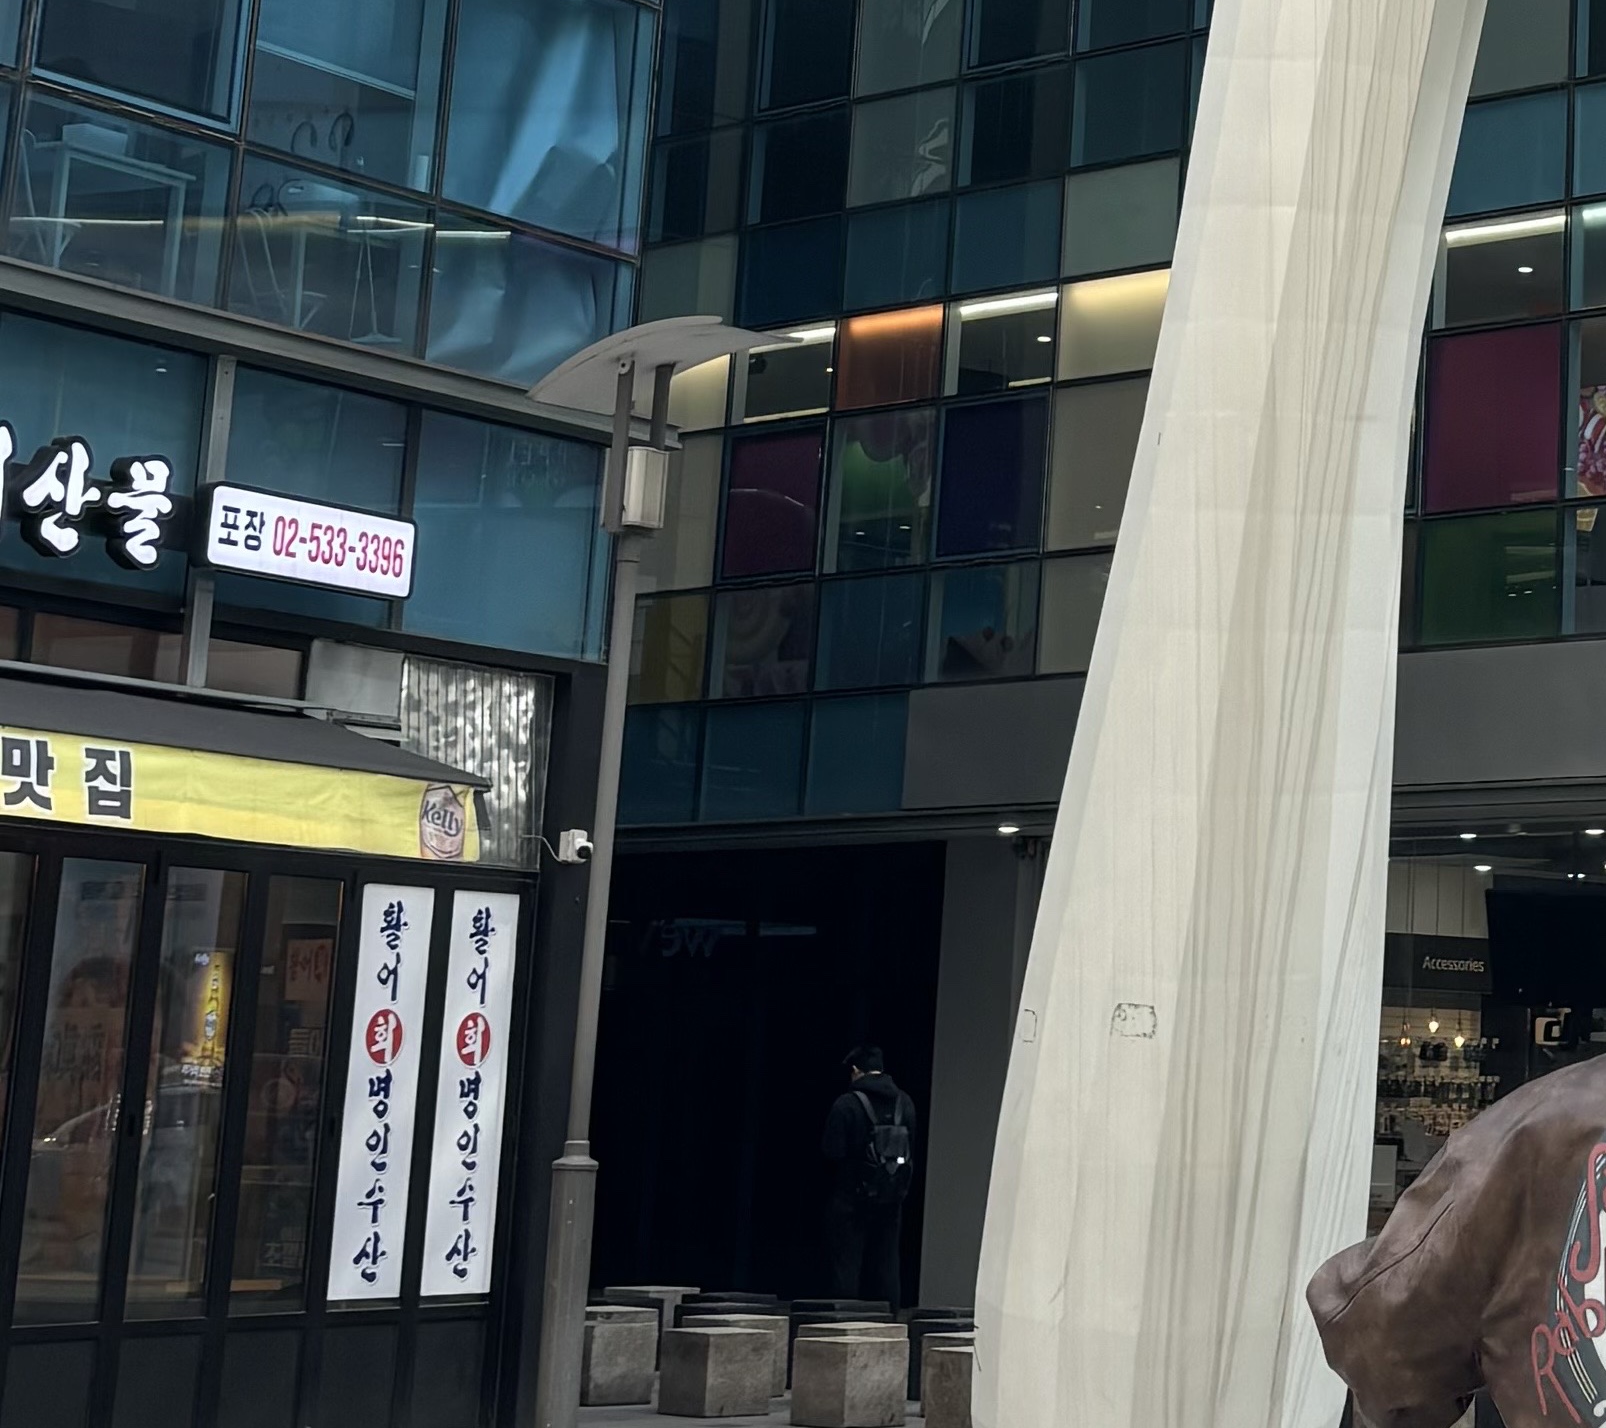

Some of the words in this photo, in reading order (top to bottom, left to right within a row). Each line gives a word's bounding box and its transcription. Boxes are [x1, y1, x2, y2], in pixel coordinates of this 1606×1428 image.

[0, 425, 173, 565] 산물
[218, 505, 266, 551] 포장
[272, 515, 405, 578] 02-533-3396
[421, 800, 464, 838] Kelly
[1422, 955, 1485, 973] Accessories
